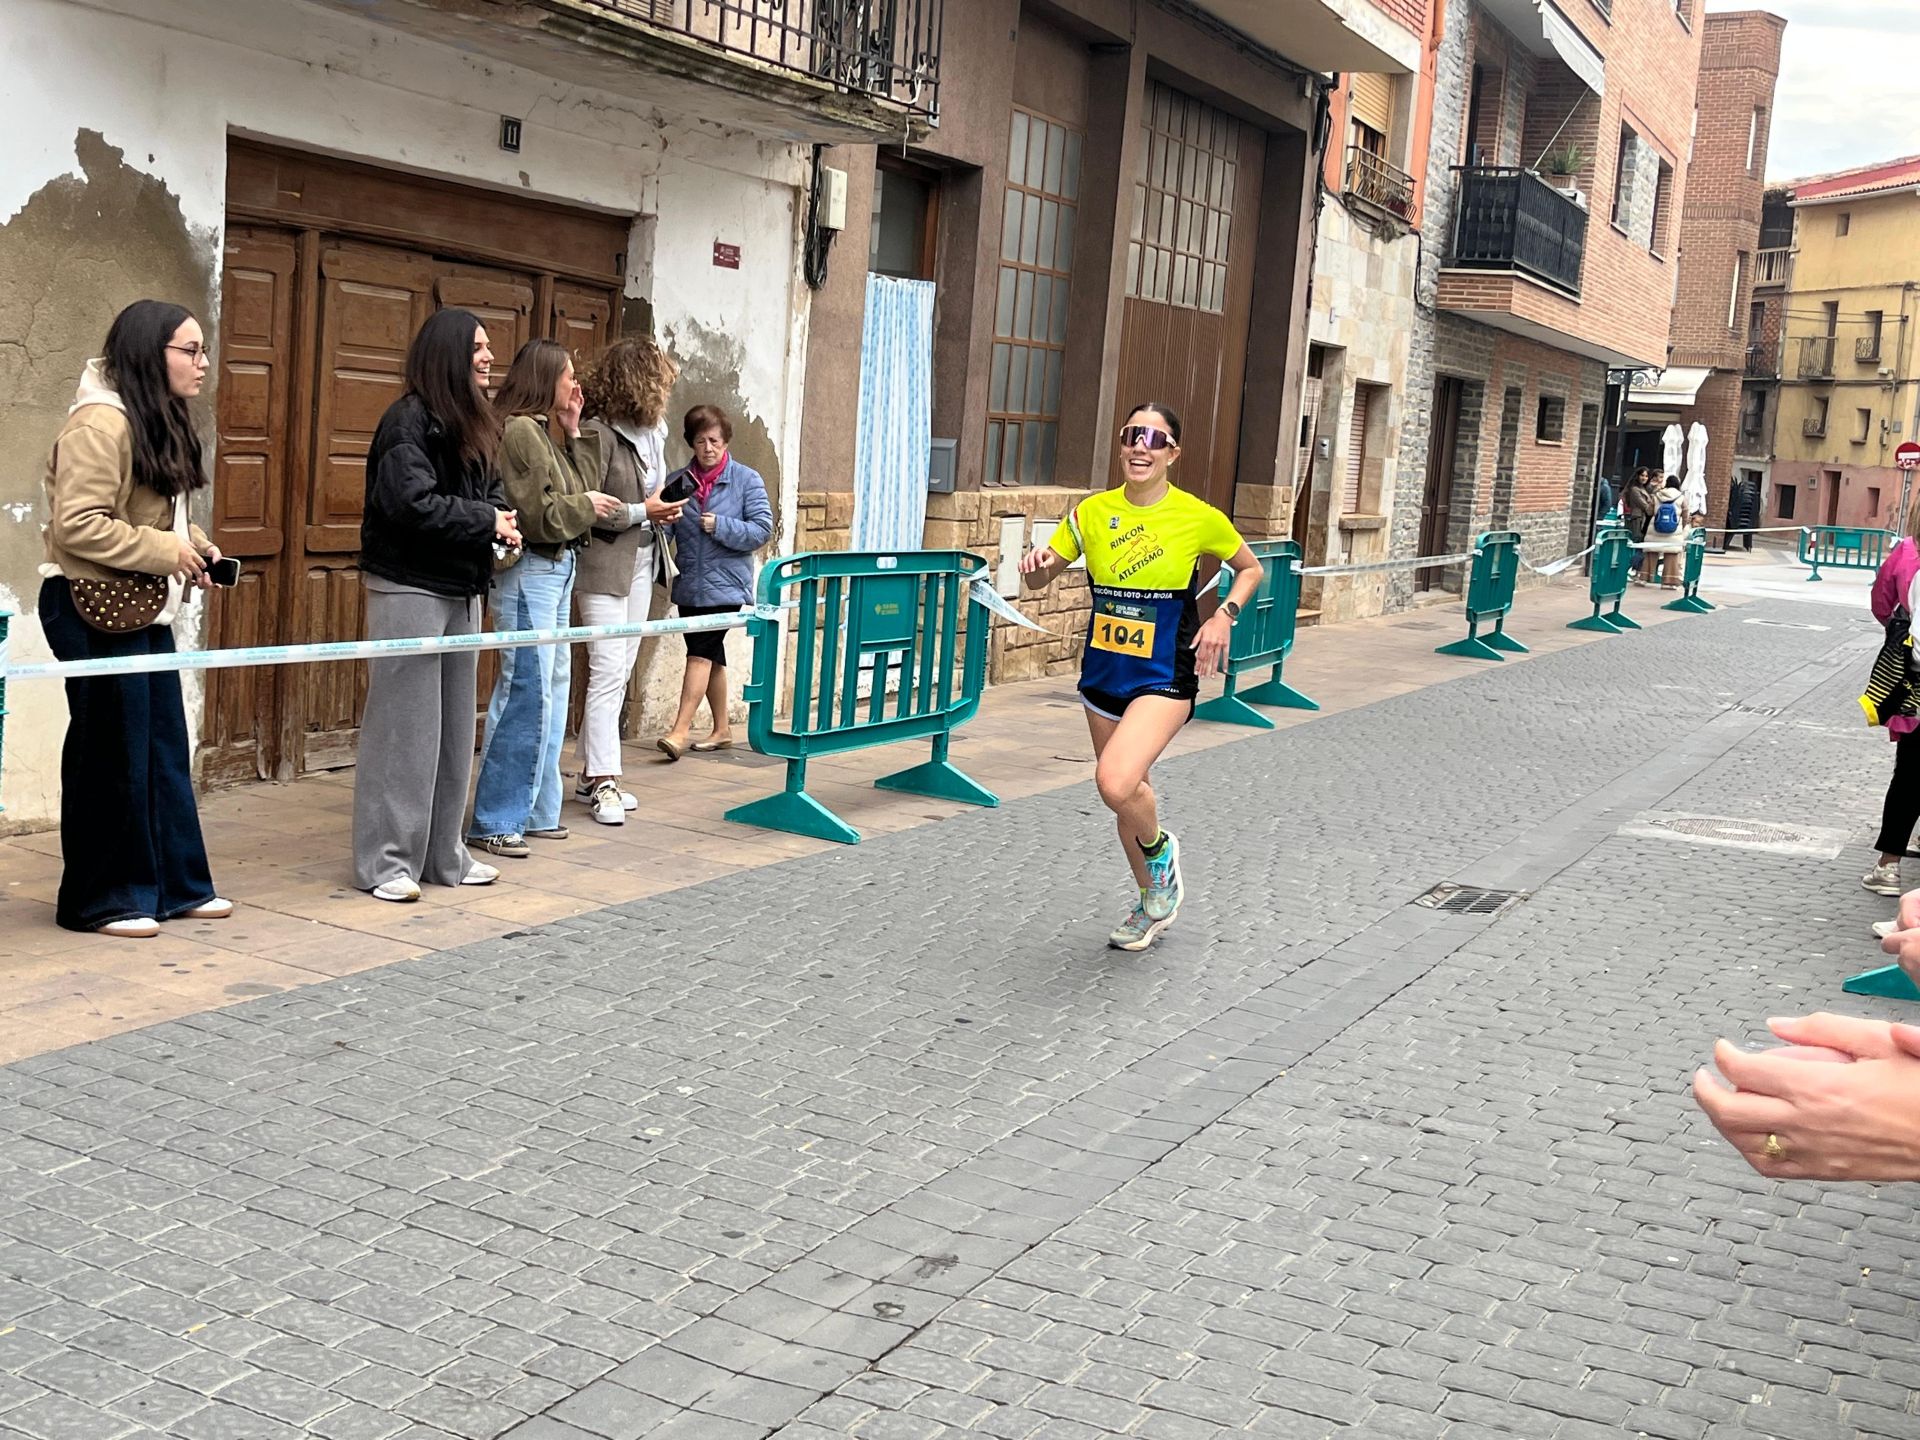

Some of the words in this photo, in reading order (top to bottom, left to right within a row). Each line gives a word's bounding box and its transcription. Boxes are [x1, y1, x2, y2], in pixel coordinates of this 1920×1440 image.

[507, 125, 517, 145] 11
[1110, 524, 1145, 550] RINCON
[1118, 548, 1164, 582] ATLETISMO
[1101, 622, 1145, 648] 104
